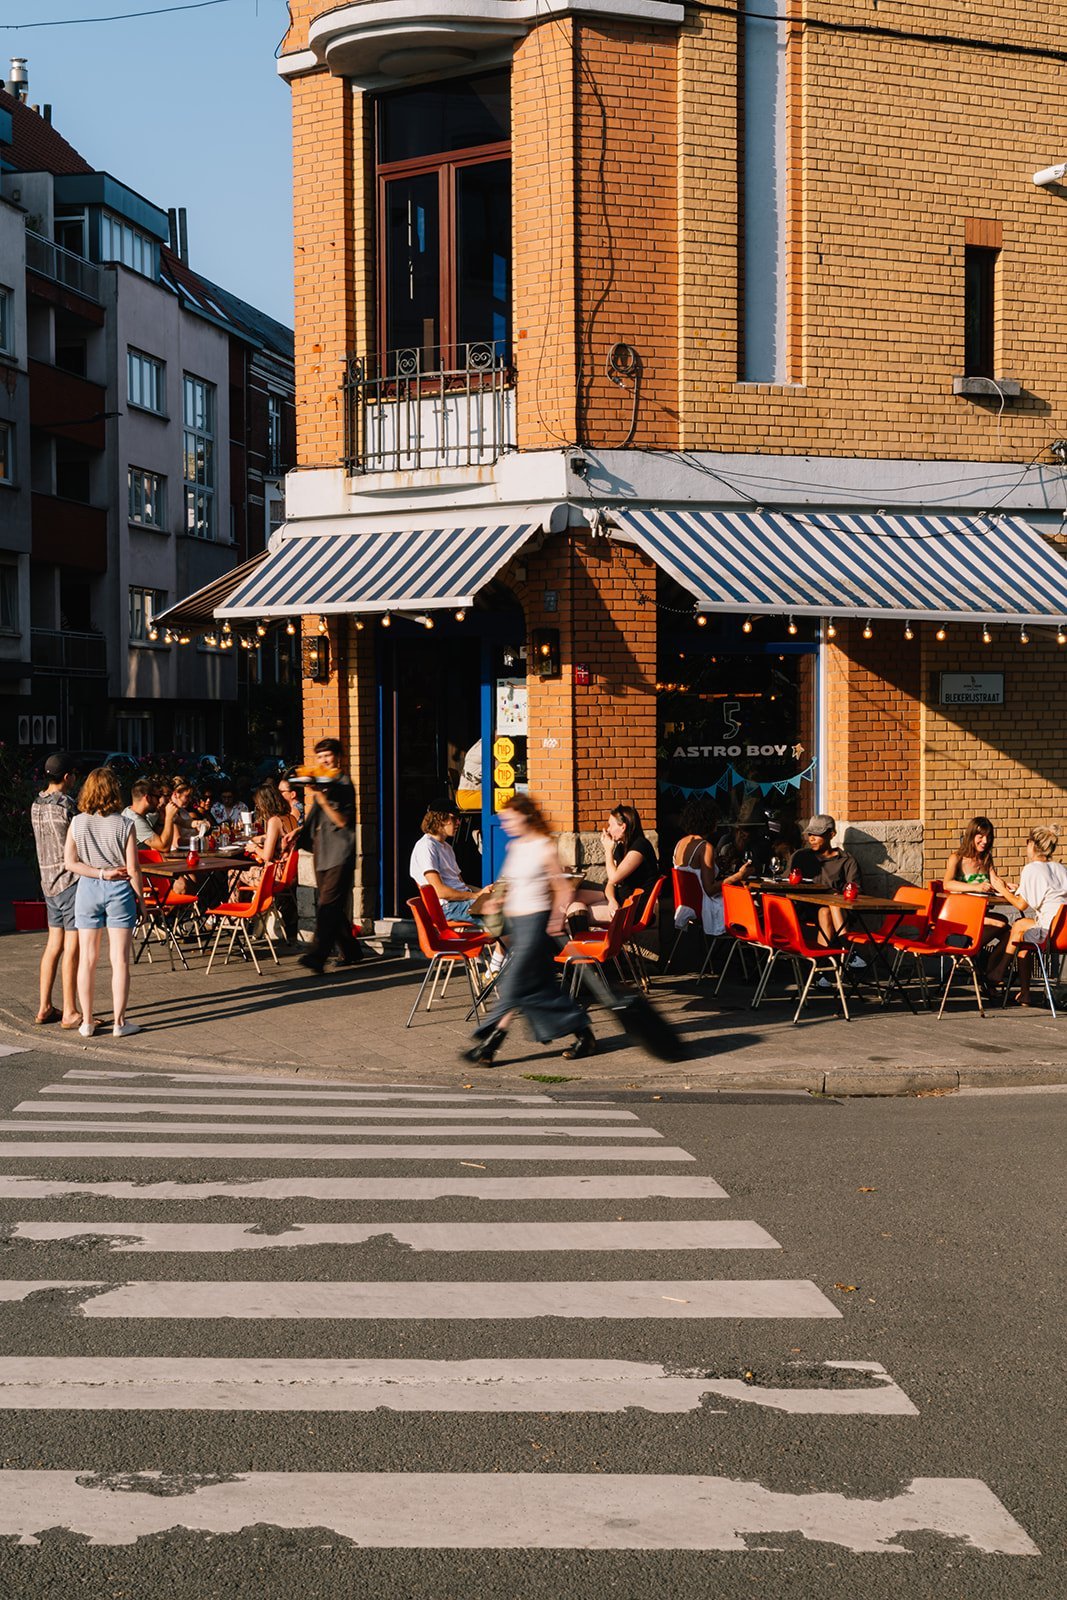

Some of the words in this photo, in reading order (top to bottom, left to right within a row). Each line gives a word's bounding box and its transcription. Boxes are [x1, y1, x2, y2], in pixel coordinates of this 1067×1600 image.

[945, 693, 1000, 703] BLEKERIJSTRAAT
[673, 745, 742, 758] ASTRO
[747, 744, 787, 756] BOY
